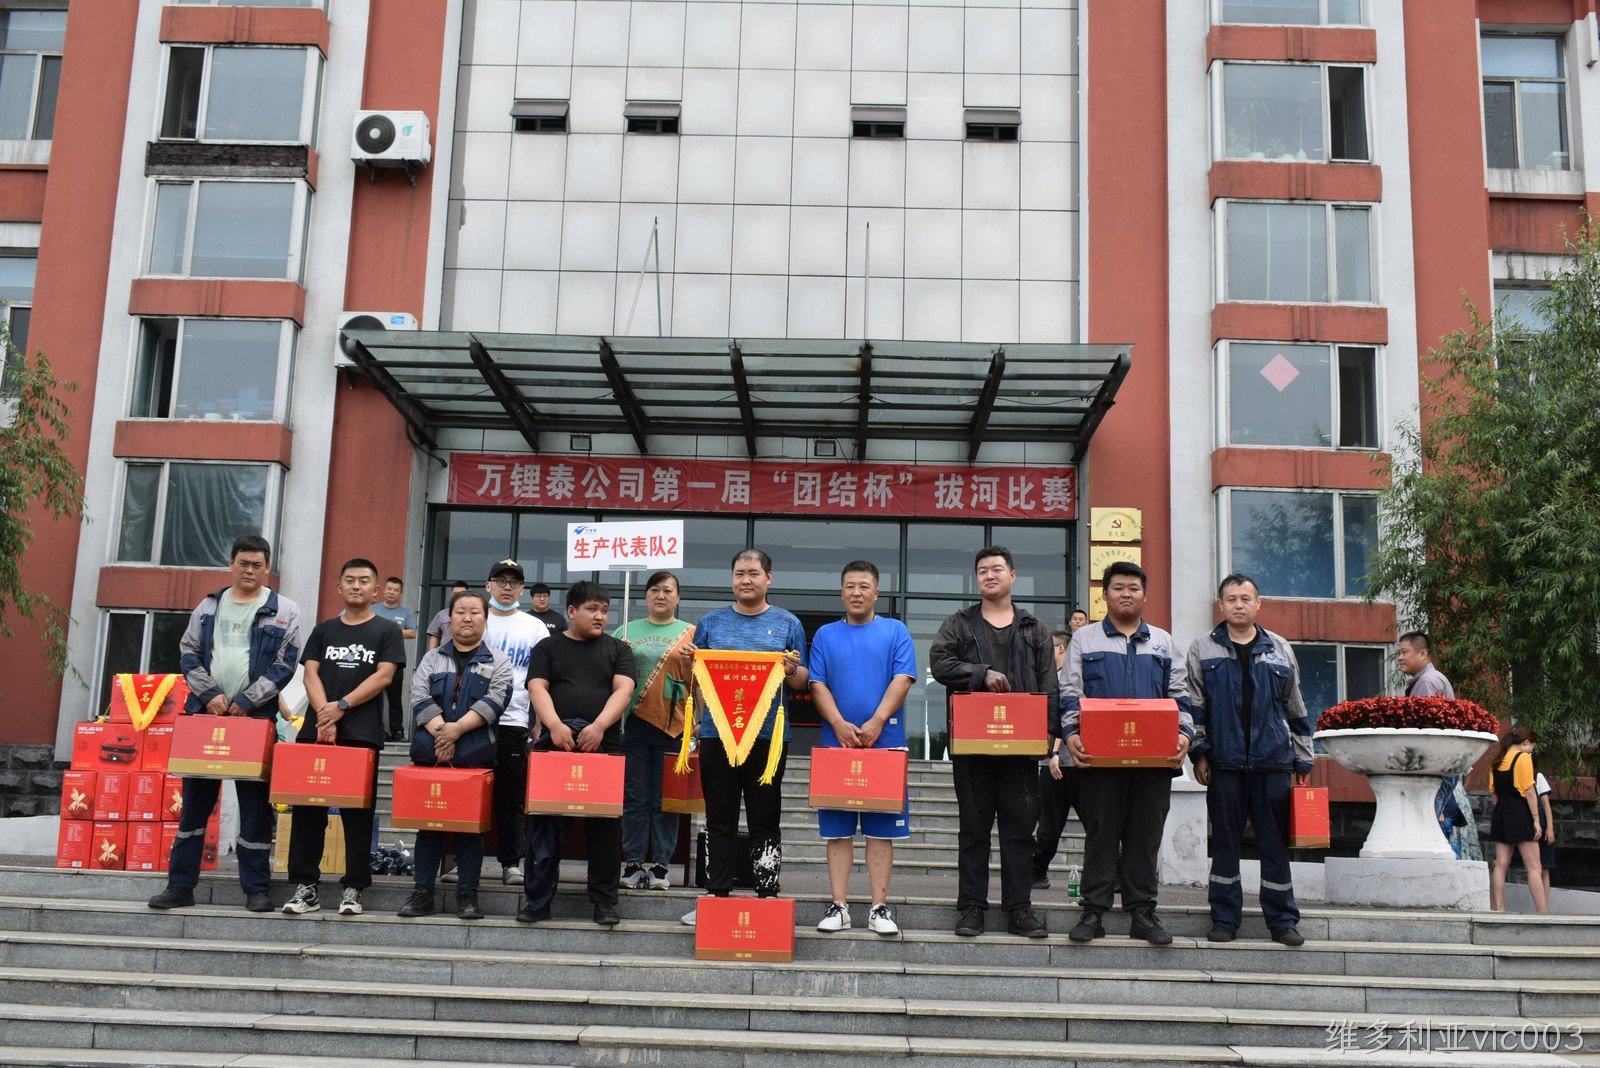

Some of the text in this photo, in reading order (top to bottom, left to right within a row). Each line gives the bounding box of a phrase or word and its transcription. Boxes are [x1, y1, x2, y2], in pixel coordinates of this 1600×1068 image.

[573, 535, 678, 559] 生产代表队2
[732, 688, 746, 728] 第三名
